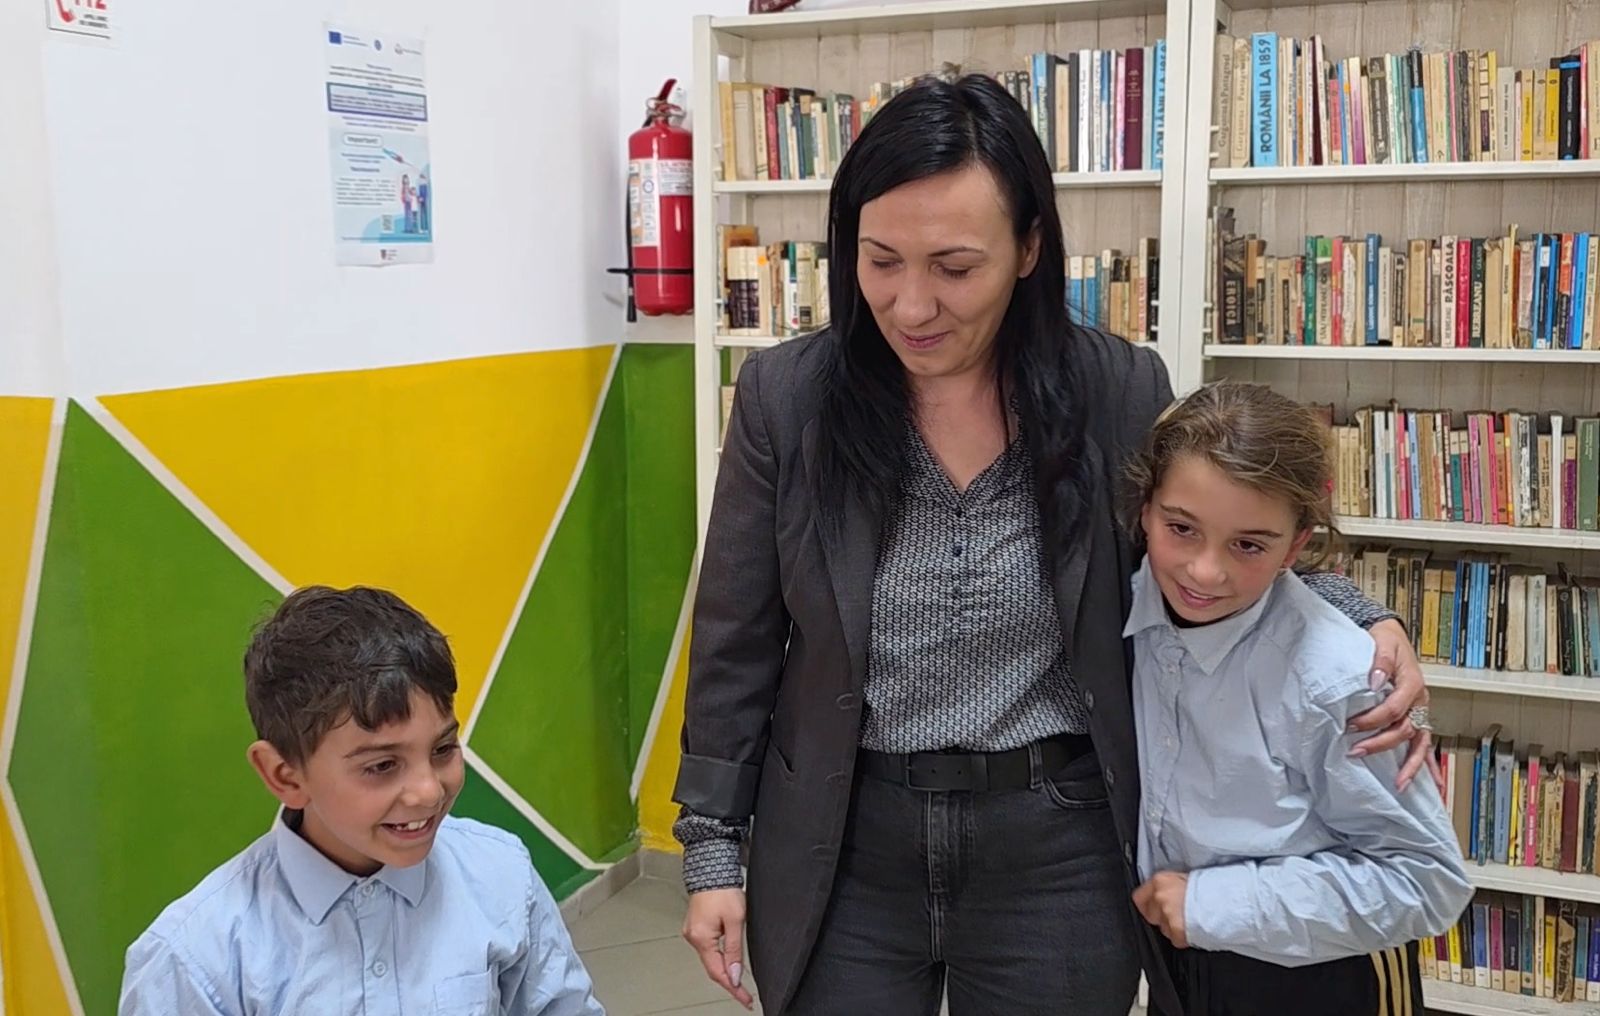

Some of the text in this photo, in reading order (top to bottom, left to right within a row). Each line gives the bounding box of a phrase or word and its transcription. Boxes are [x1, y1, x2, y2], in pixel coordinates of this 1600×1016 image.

[1258, 38, 1273, 153] ROMÂNII LA 1859
[1226, 281, 1236, 325] EROICA
[1471, 281, 1483, 338] REBREANU
